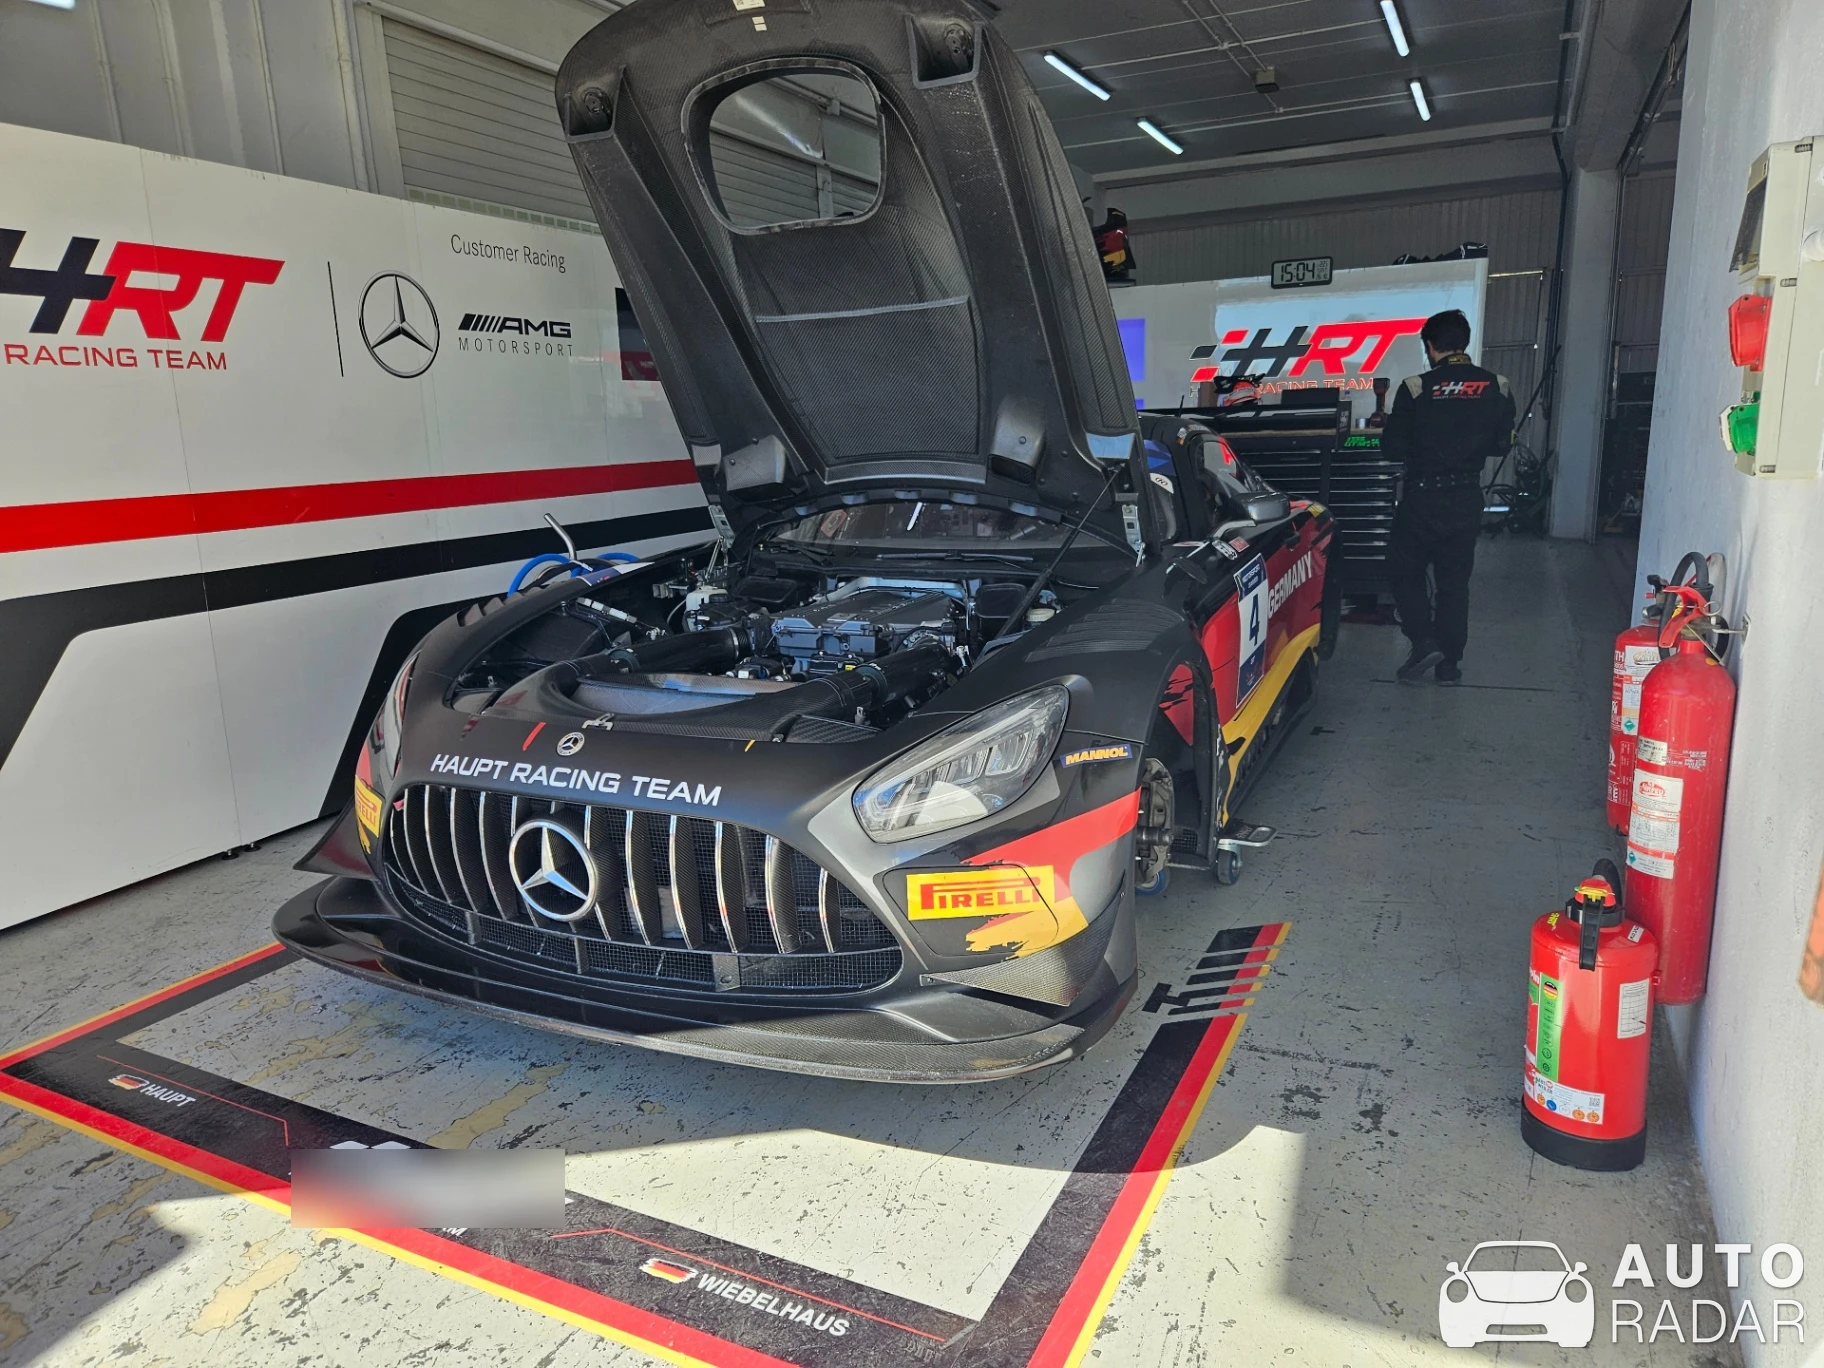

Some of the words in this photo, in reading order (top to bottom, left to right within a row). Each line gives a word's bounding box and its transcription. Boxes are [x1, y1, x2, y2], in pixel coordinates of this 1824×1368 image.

[450, 234, 519, 262] Customer
[522, 245, 566, 274] Racing
[1280, 262, 1315, 283] 15:04
[496, 316, 571, 339] AMG
[4, 343, 138, 368] RACING
[147, 349, 228, 371] TEAM
[458, 336, 573, 357] MOTORSPORT
[1221, 317, 1428, 378] HRT
[1323, 377, 1374, 391] TEAM
[1441, 381, 1490, 396] HRT
[1268, 551, 1312, 619] GERMANY
[1249, 593, 1260, 647] 4
[1065, 746, 1129, 766] MANNOL
[430, 753, 509, 780] HAUPT
[510, 762, 622, 795] RACING
[631, 774, 722, 807] TEAM
[920, 876, 1041, 910] PIRELLI
[140, 1083, 196, 1107] HAUPT
[697, 1273, 851, 1338] WIEBELHAUS
